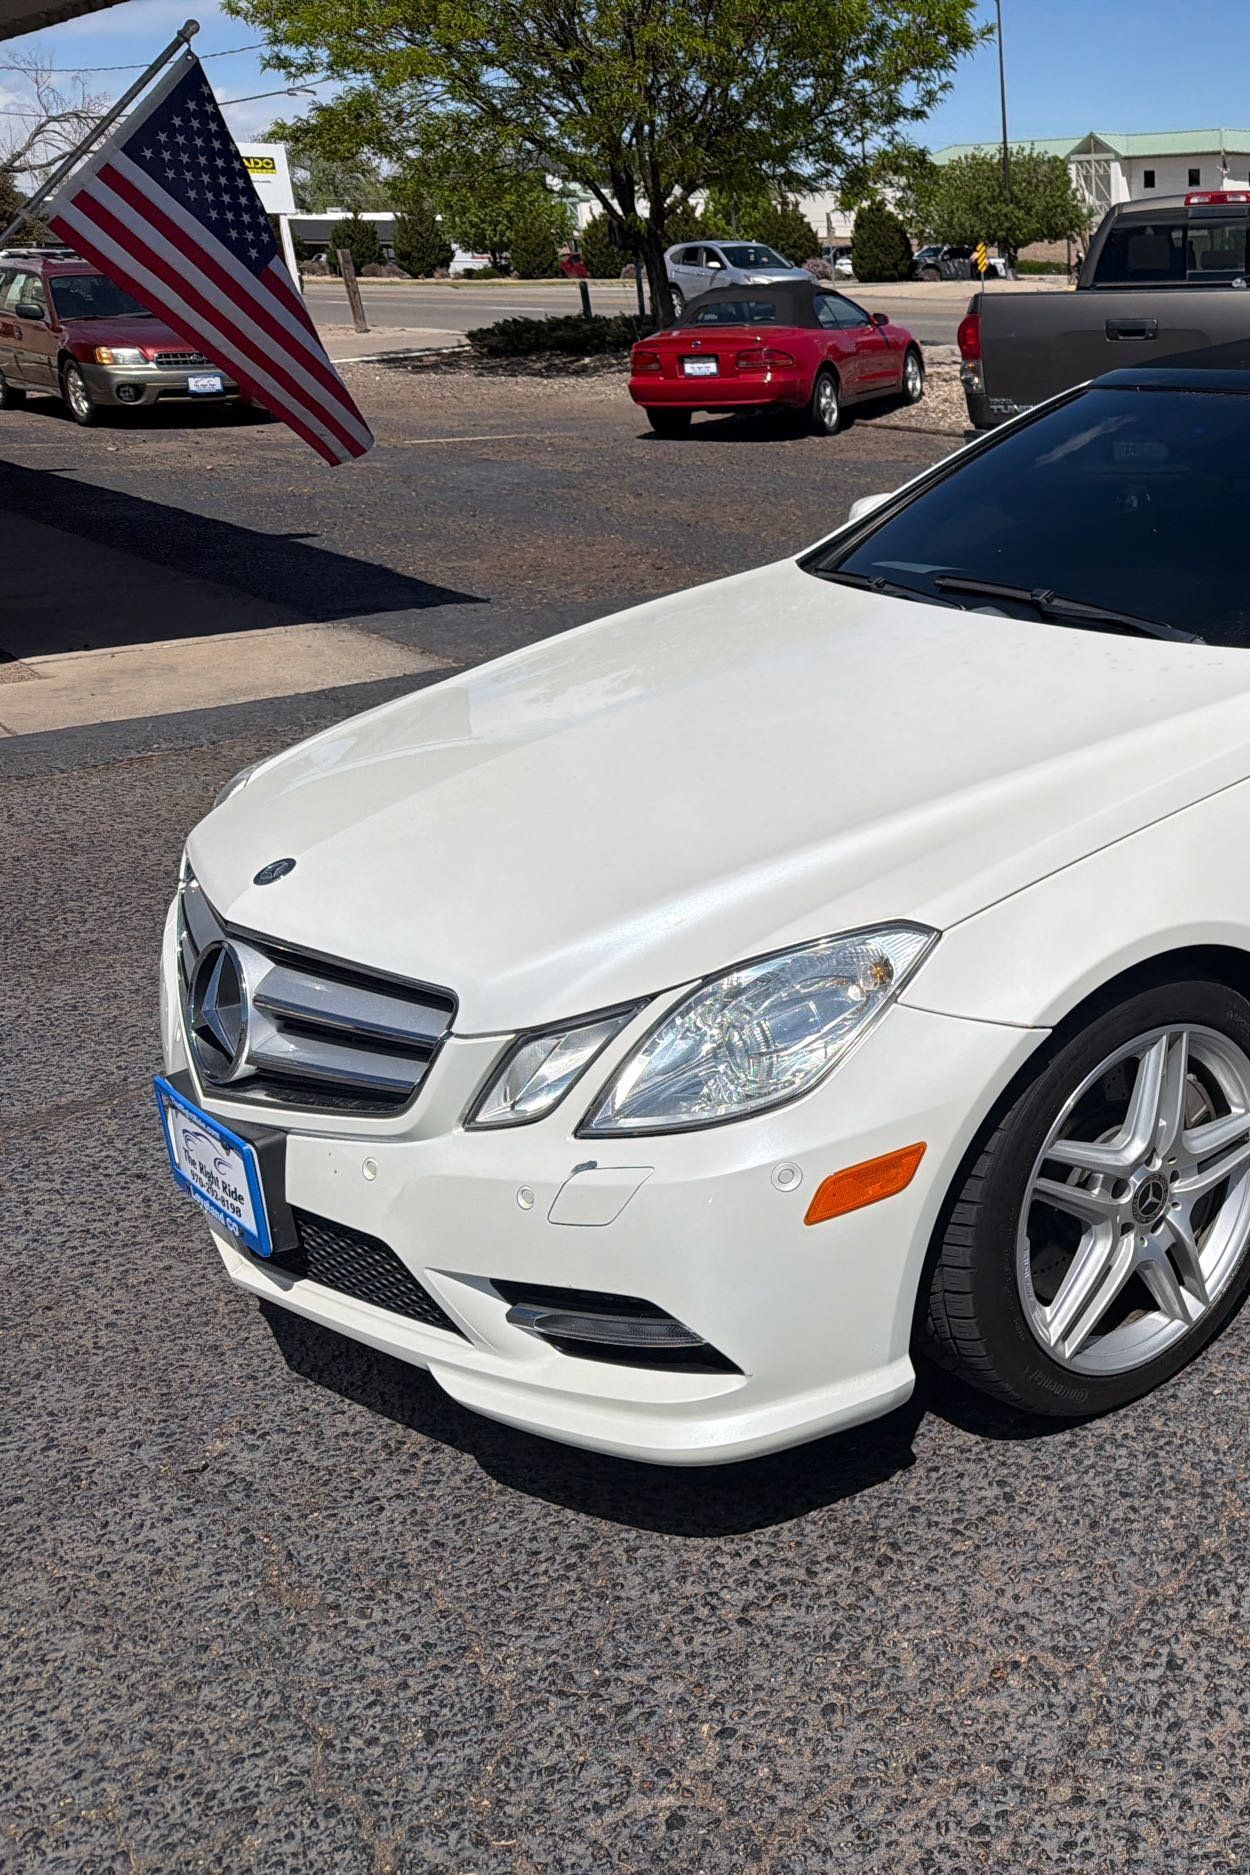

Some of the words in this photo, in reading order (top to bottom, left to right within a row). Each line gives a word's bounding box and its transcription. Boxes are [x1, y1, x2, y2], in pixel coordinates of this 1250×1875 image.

[183, 1146, 197, 1169] The
[198, 1161, 220, 1189] Right
[221, 1180, 245, 1206] Ride
